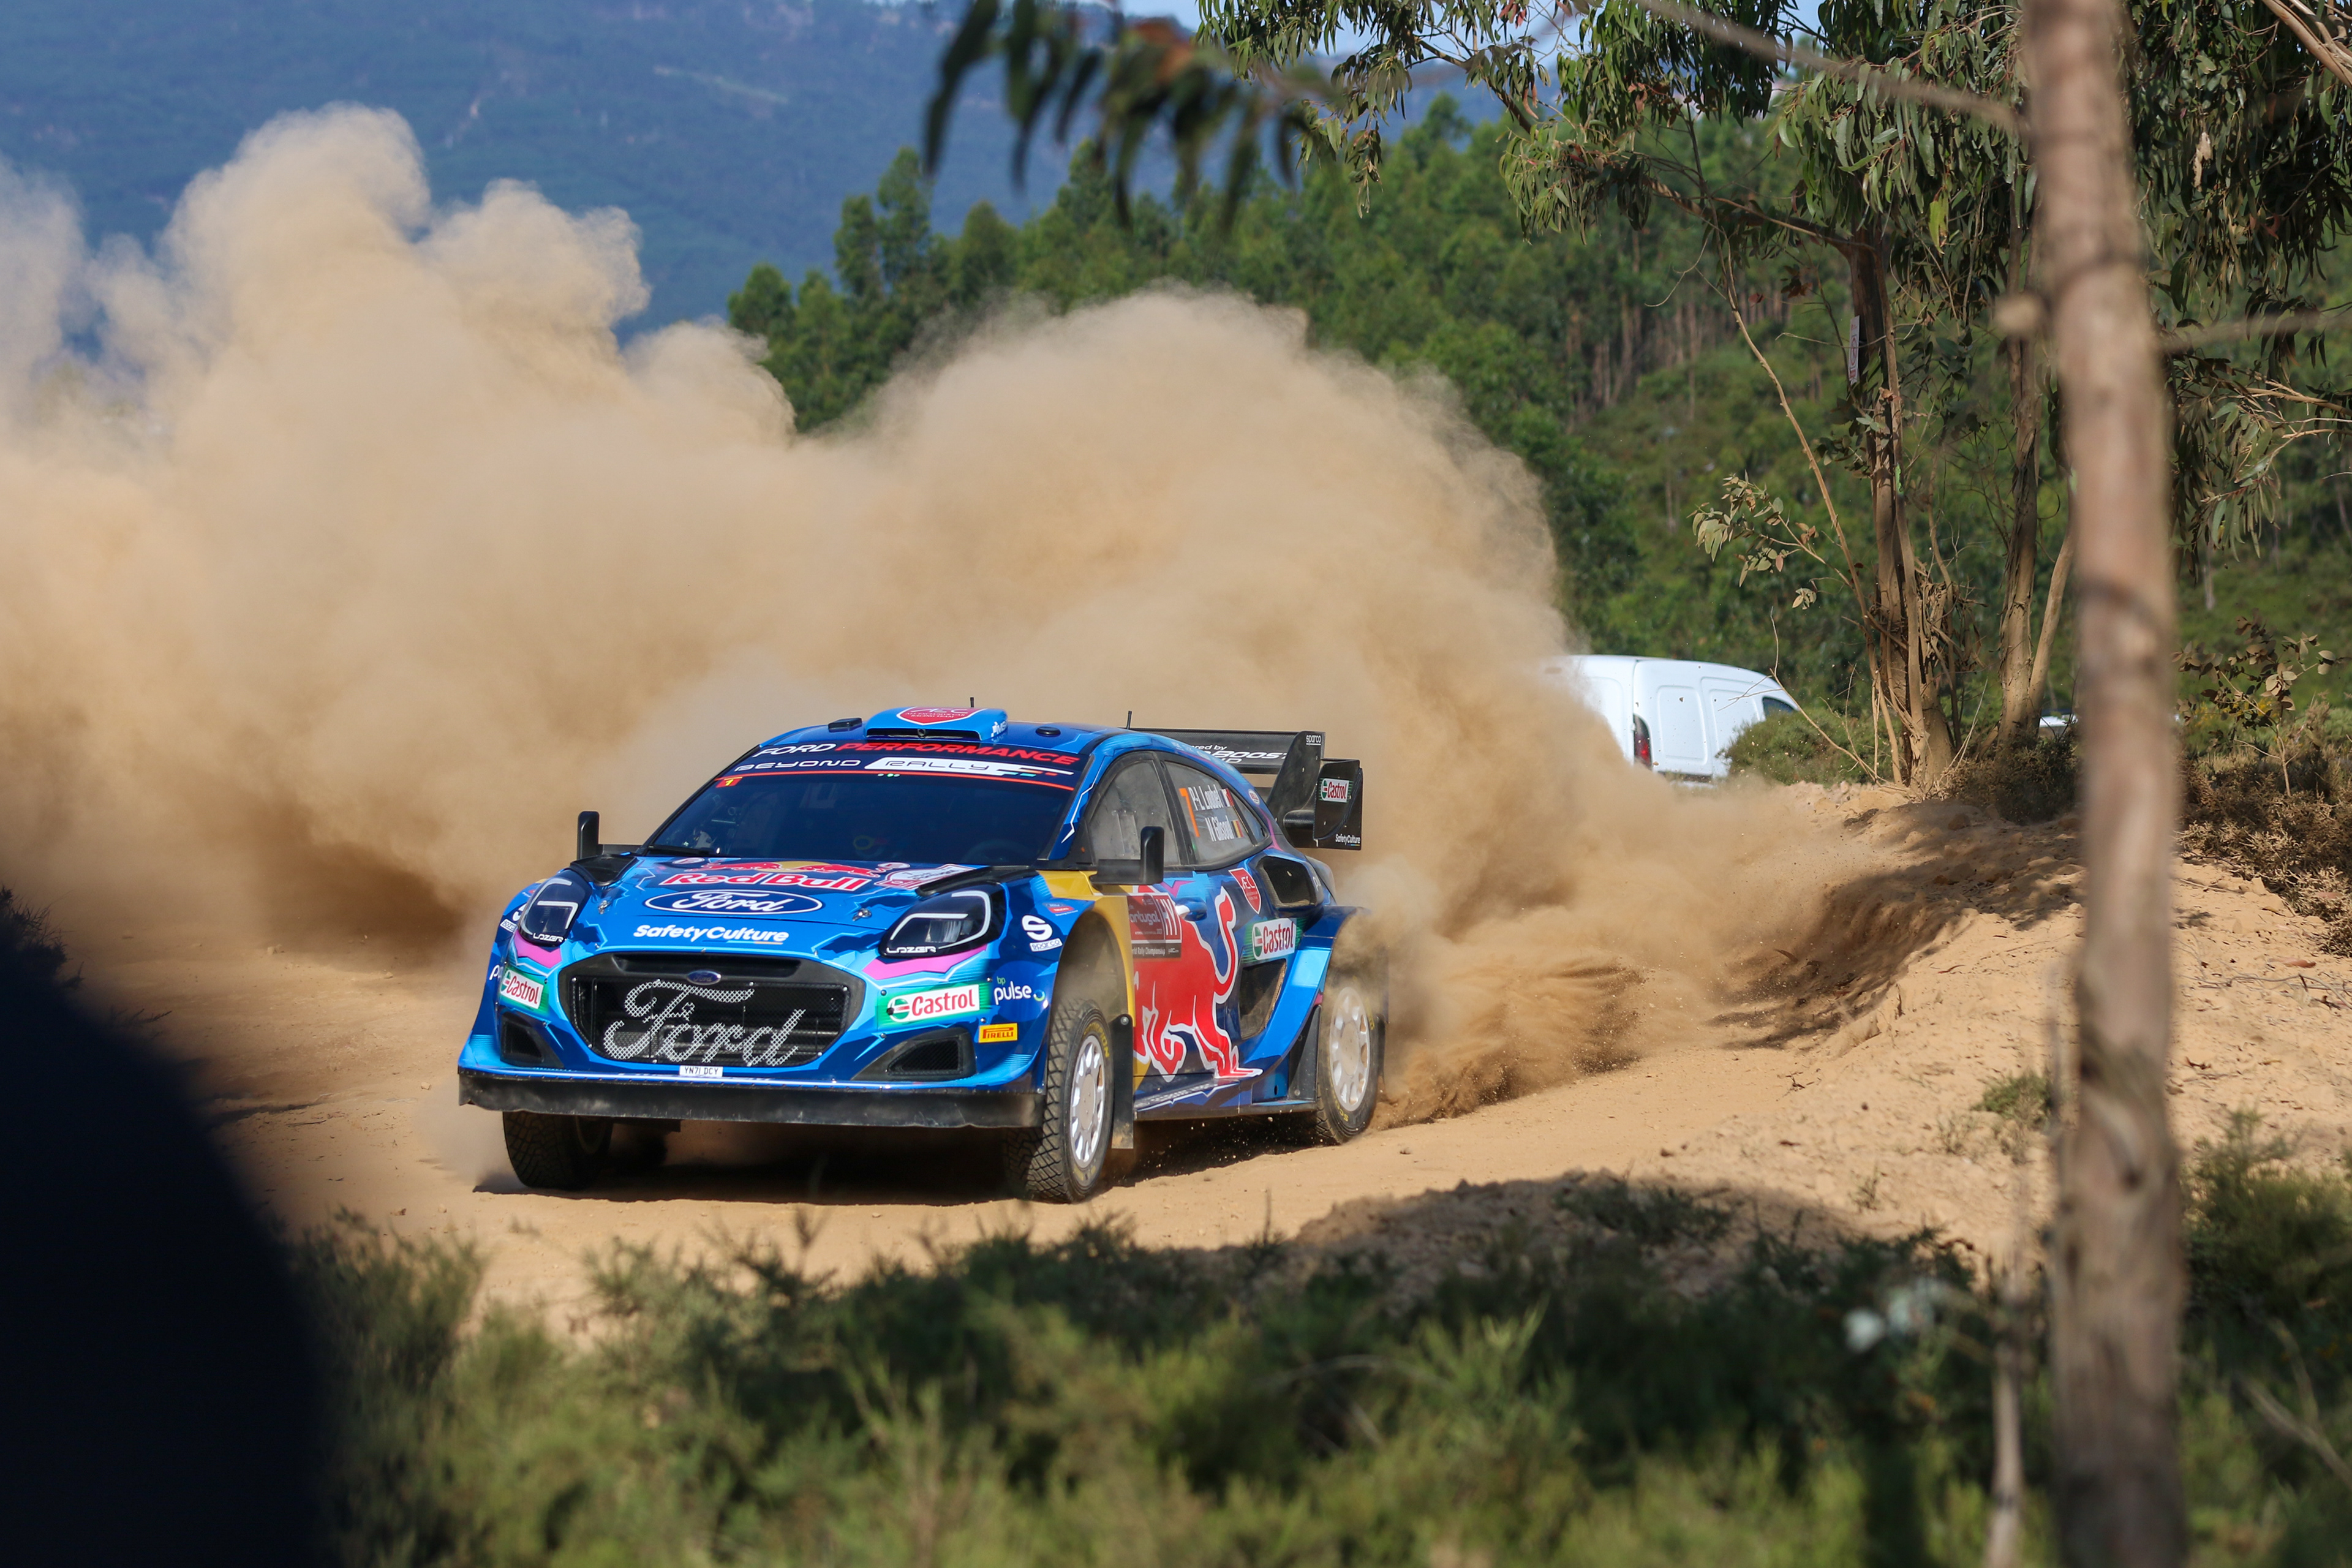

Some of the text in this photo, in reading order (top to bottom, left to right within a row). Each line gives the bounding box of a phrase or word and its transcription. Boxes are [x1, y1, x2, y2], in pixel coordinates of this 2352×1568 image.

[1306, 735, 1322, 744] sparco
[752, 742, 1080, 765] FORD PERFORMANCE
[734, 760, 989, 772] BEYOND RALLY
[1327, 782, 1348, 799] Castrol
[659, 873, 872, 891] Red Bull
[672, 891, 794, 912] Ford
[1129, 910, 1161, 925] ortugal
[633, 924, 790, 943] SafetyCulture
[1263, 921, 1294, 954] Castrol
[1031, 940, 1060, 951] sparco
[693, 972, 713, 982] Ford
[997, 976, 1006, 986] bp
[507, 975, 539, 1005] Castrol
[994, 981, 1032, 1005] pulse
[912, 989, 975, 1016] Castrol
[604, 980, 806, 1067] Ford
[982, 1027, 1014, 1039] PIRELLI
